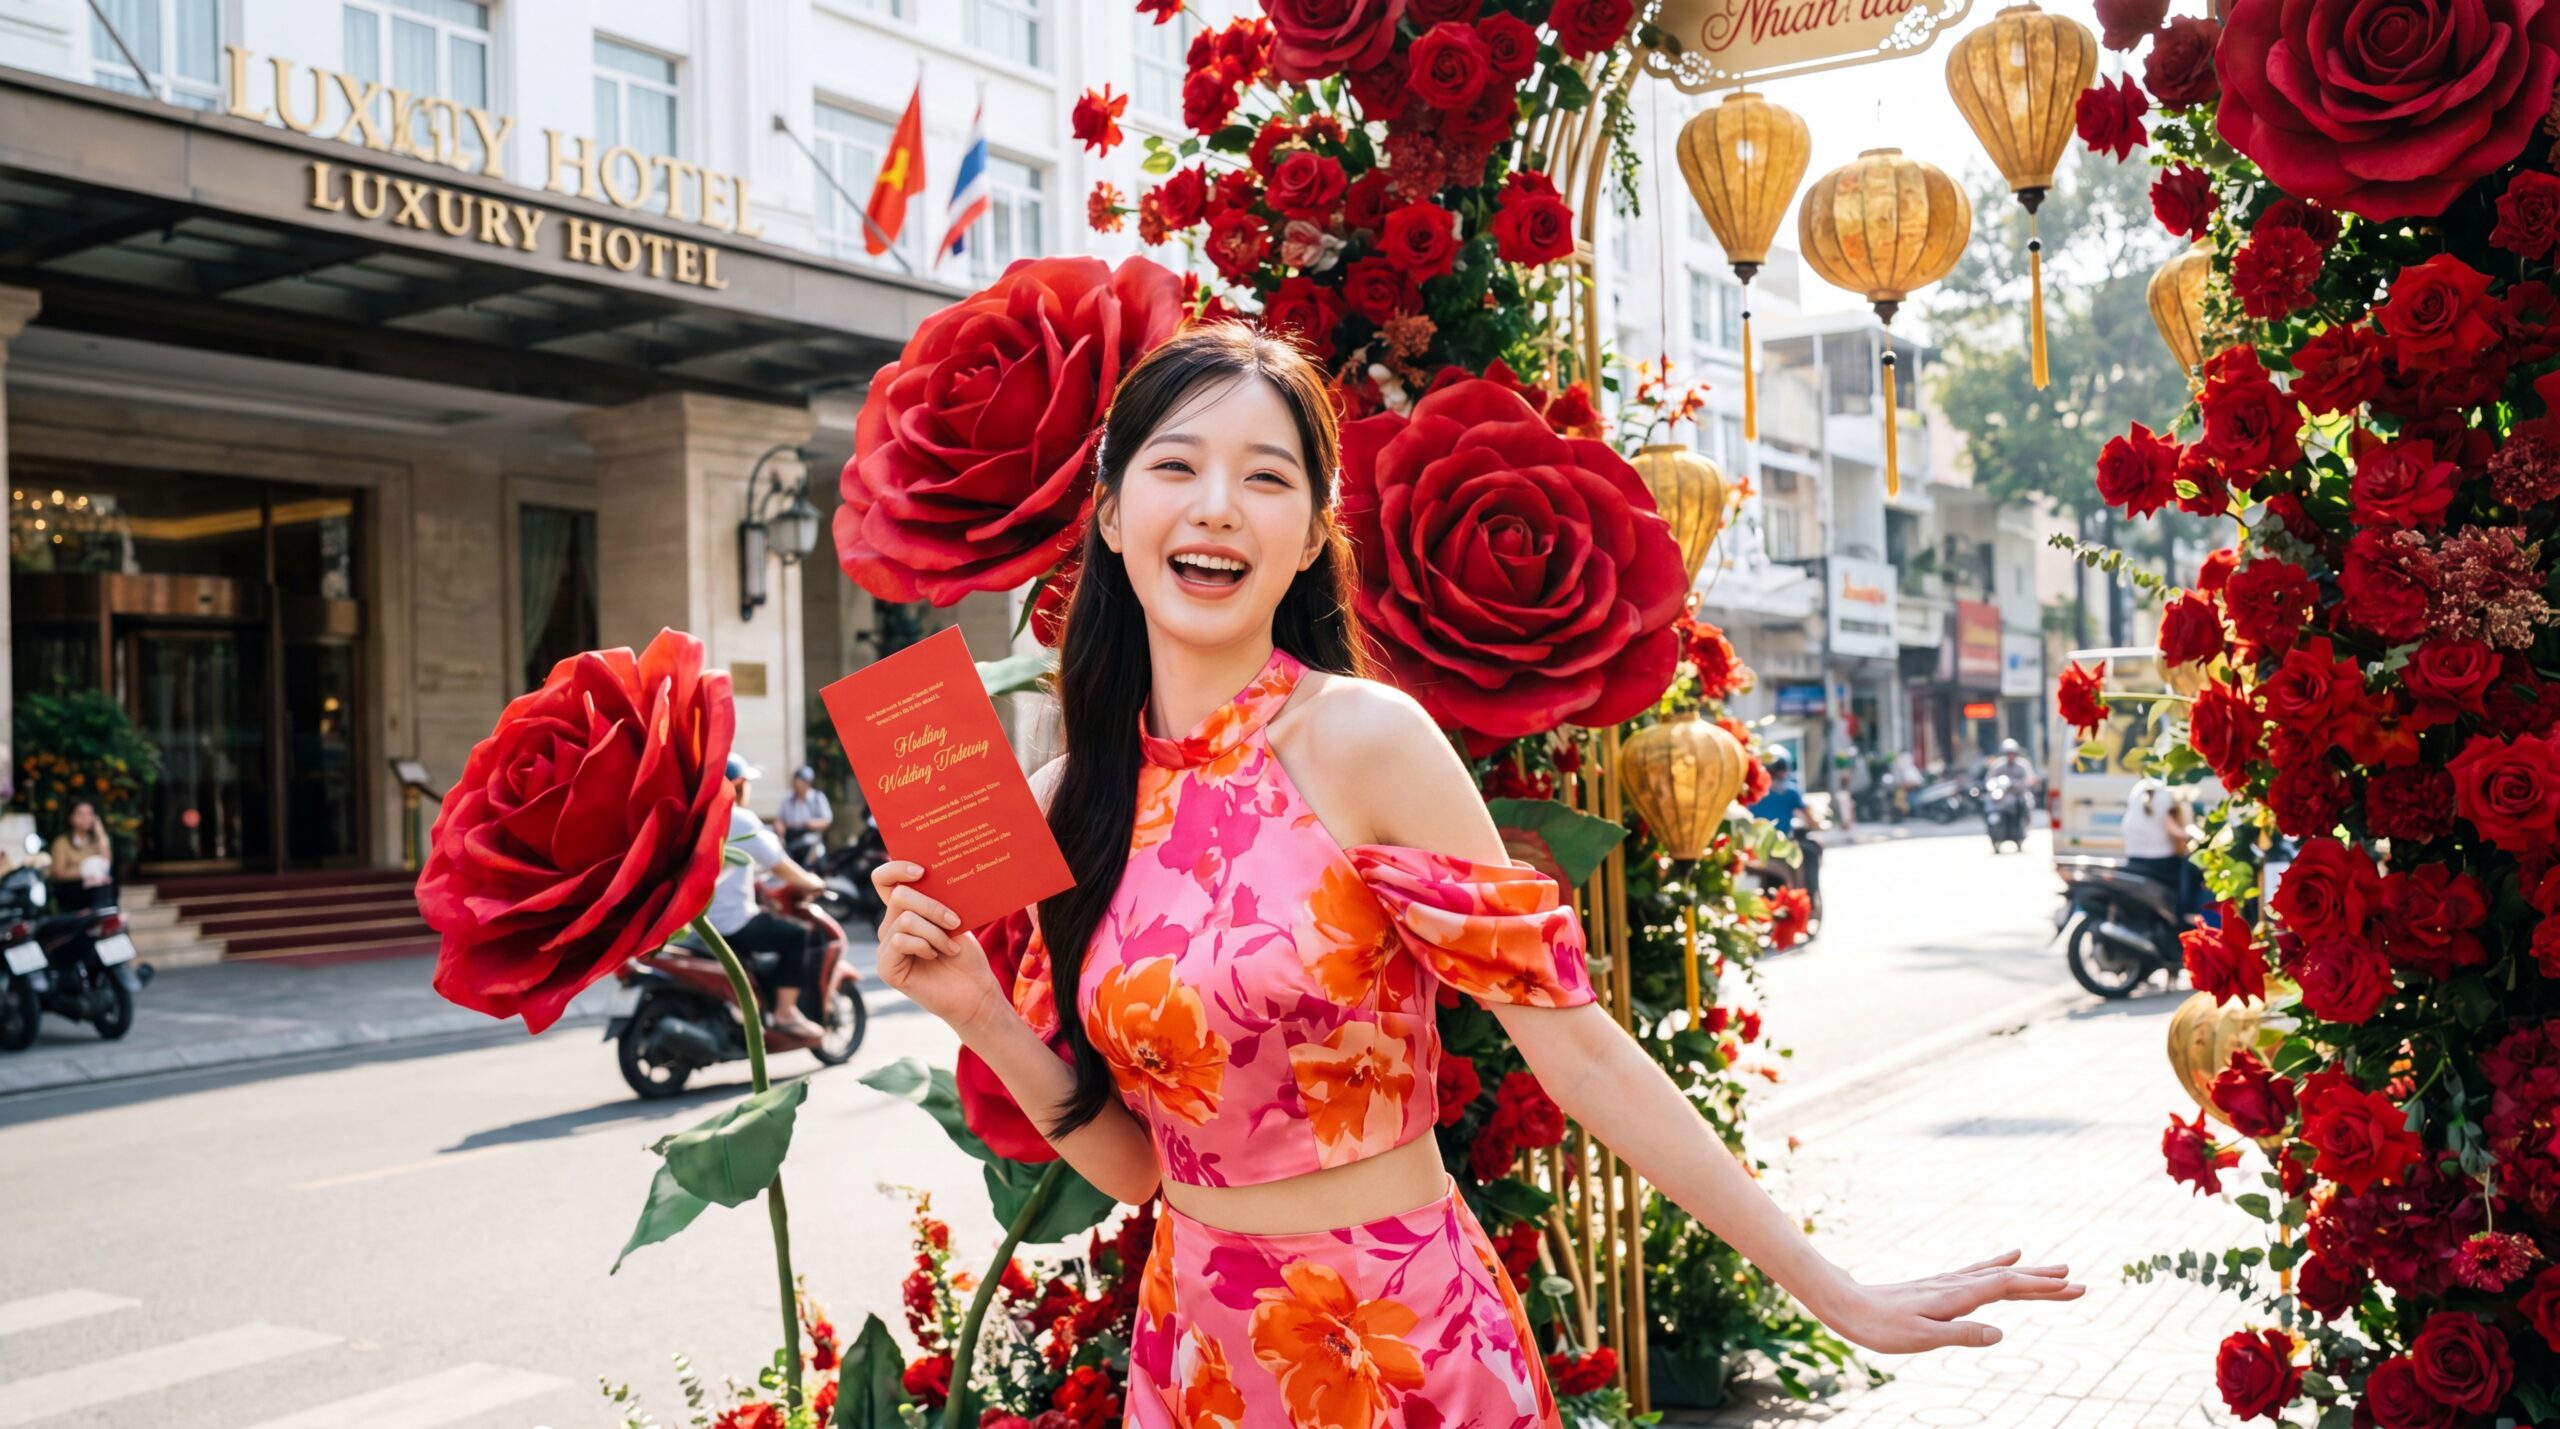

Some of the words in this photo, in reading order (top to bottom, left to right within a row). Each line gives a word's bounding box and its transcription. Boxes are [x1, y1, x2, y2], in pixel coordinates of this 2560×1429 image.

[311, 161, 545, 251] LUXURY
[566, 217, 729, 289] HOTEL
[543, 128, 764, 238] HOTEL
